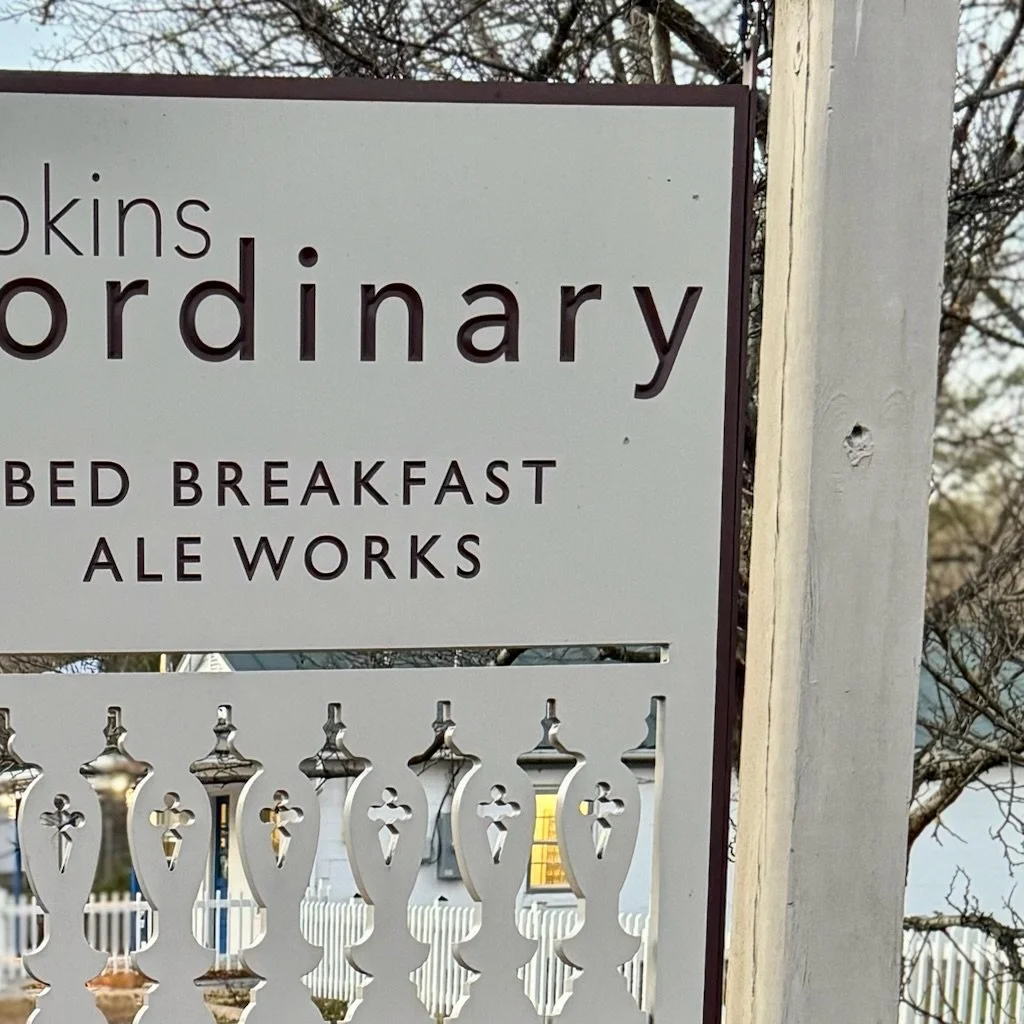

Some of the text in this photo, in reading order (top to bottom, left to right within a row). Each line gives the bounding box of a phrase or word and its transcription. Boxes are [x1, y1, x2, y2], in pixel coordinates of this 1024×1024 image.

[4, 459, 558, 507] BED BREAKFAST
[82, 533, 482, 583] ALE WORKS
